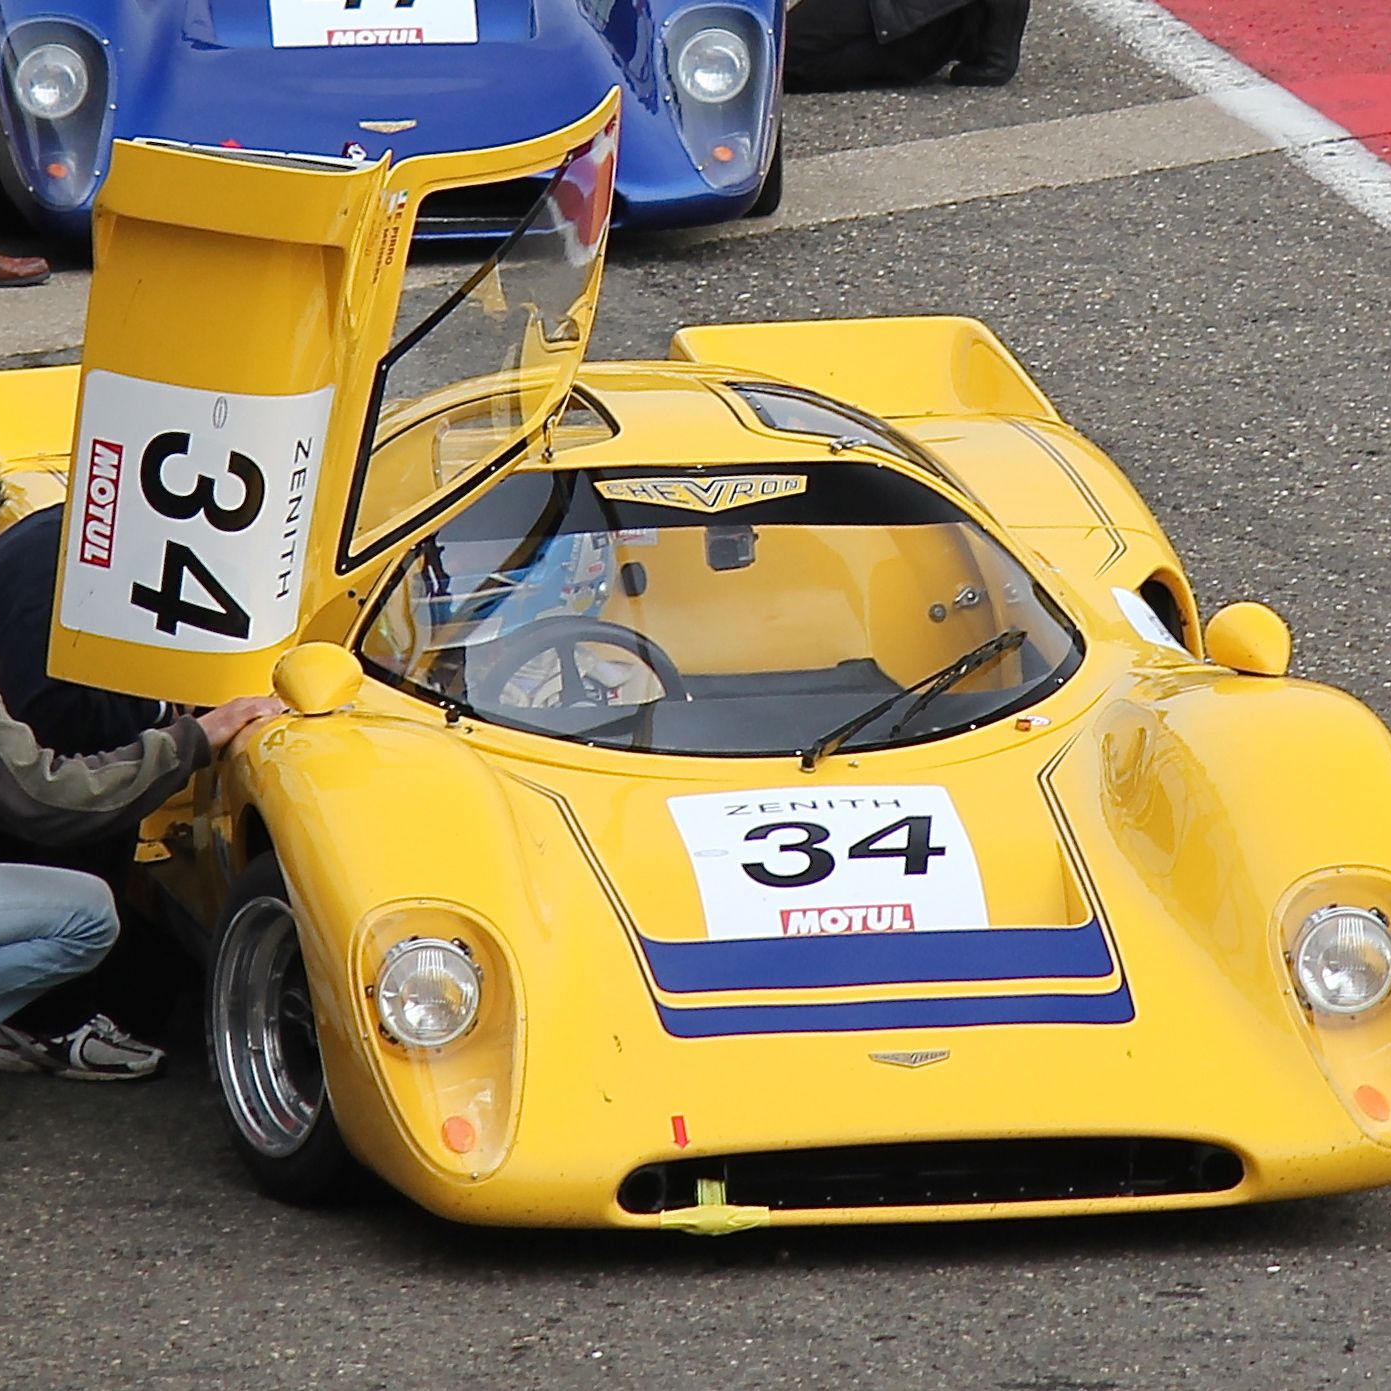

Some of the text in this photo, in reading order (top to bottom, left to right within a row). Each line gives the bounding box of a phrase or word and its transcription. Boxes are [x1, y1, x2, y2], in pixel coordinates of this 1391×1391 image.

[330, 29, 423, 46] MOTUL
[385, 226, 400, 266] PIRRO
[82, 441, 121, 568] MOTUL
[605, 478, 802, 509] CHEVRON
[130, 430, 266, 640] 34
[276, 436, 313, 599] ZENITH
[724, 798, 902, 816] ZENITH
[741, 815, 947, 888] 34
[785, 905, 912, 935] MOTUL
